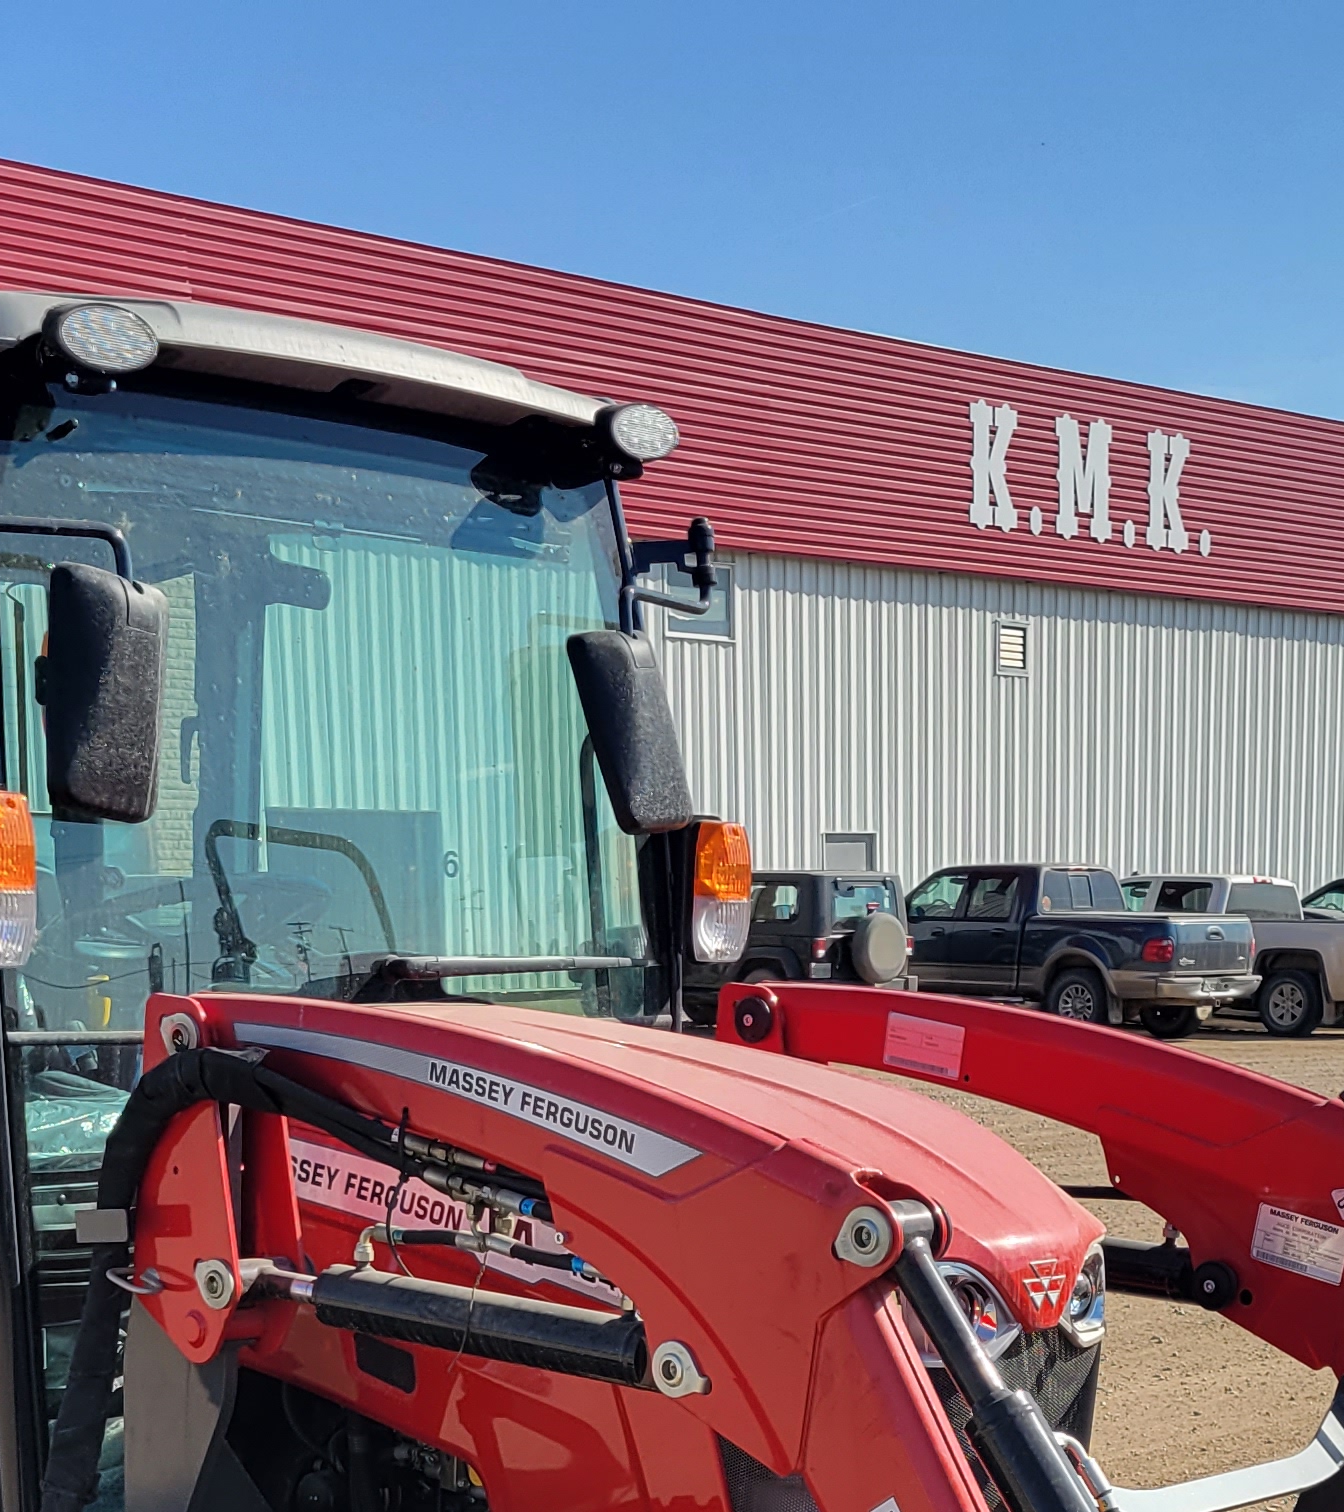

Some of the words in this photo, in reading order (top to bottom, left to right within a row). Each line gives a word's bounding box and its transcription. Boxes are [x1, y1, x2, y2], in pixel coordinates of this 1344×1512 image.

[969, 399, 1212, 557] K.M.K.
[444, 850, 459, 878] 6
[429, 1062, 515, 1106] MASSEY
[520, 1091, 636, 1154] FERGUSON
[1269, 1208, 1299, 1222] MASSEY
[1300, 1218, 1339, 1235] FERGUSON
